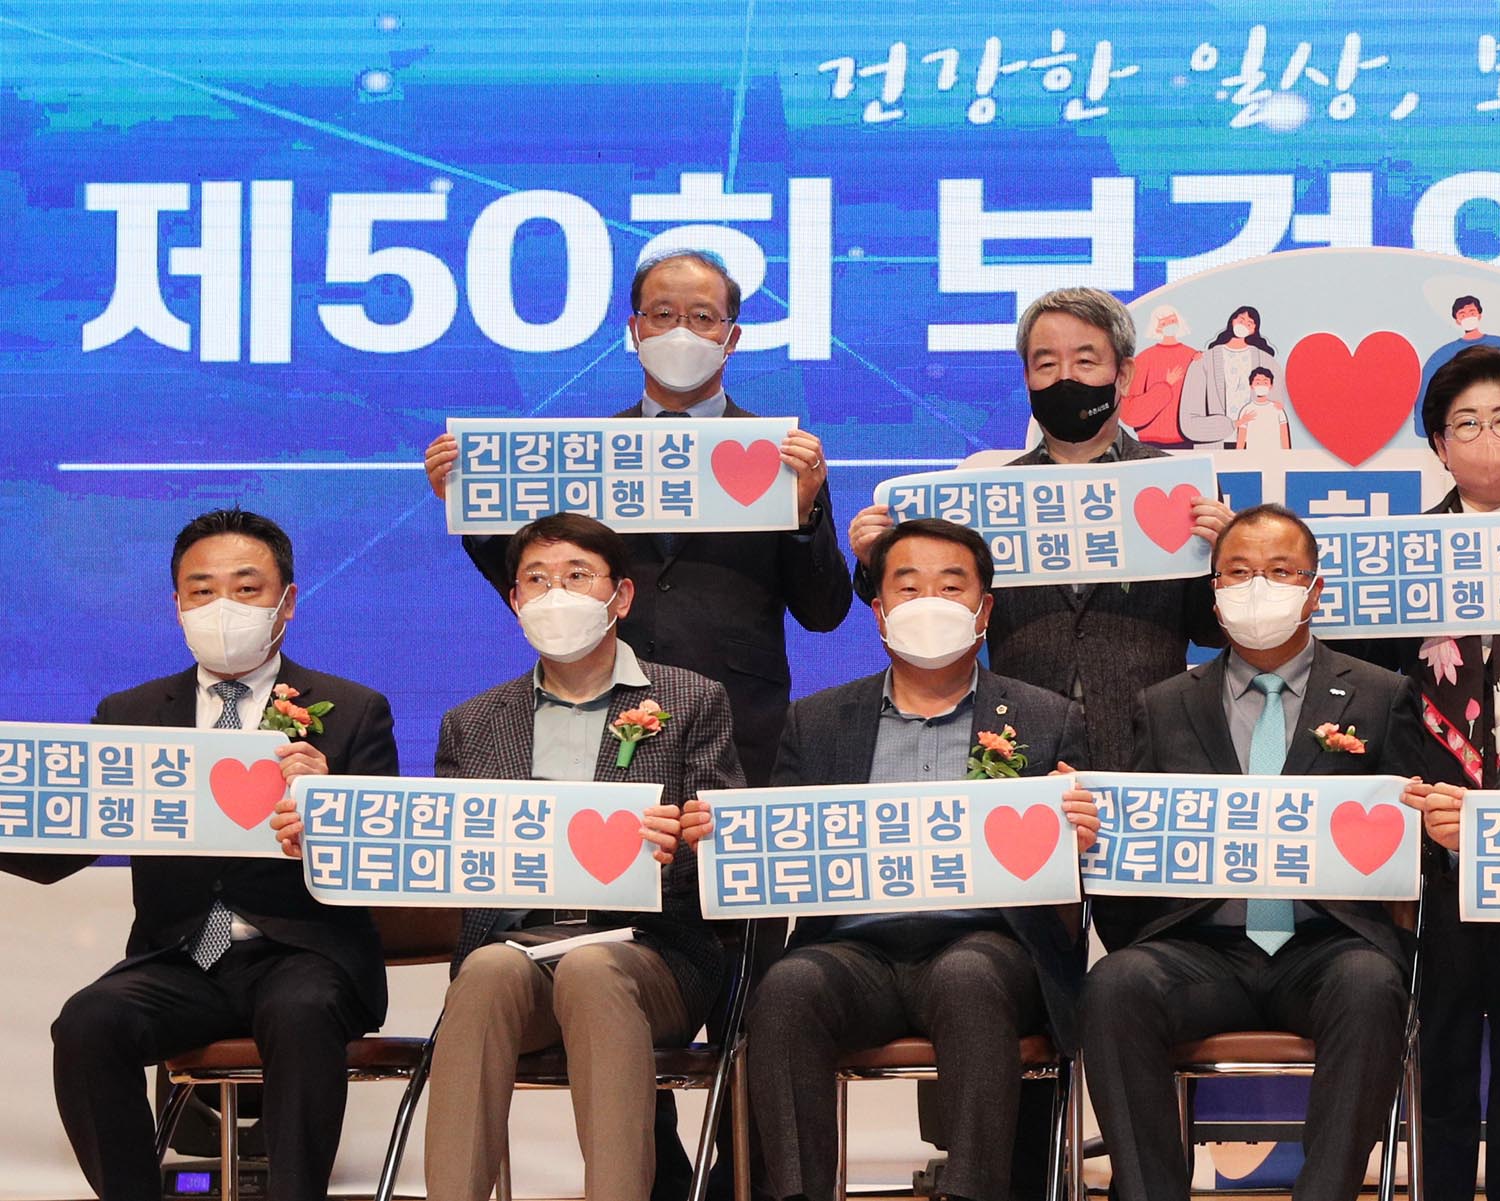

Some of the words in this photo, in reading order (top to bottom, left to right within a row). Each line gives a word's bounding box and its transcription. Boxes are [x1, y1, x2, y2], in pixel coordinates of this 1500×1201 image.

[819, 27, 1138, 125] 건강한
[1190, 25, 1420, 129] 일상,
[82, 172, 832, 364] 제50회
[467, 433, 599, 473] 건강한
[611, 434, 694, 470] 일상
[467, 481, 597, 519] 모두의
[612, 480, 693, 517] 행복
[893, 483, 1022, 525] 건강한
[1032, 482, 1116, 526] 일상
[1036, 531, 1119, 571] 행복
[1318, 533, 1439, 577] 건강한
[1312, 582, 1431, 623] 모두의
[0, 743, 85, 785] 강한
[98, 746, 190, 788] 일상
[0, 794, 81, 836] 두의
[99, 797, 189, 839] 행복
[311, 793, 450, 837] 건강한
[463, 797, 550, 841] 일상
[720, 804, 865, 851] 건강한
[875, 800, 965, 845] 일상
[1227, 792, 1313, 832] 일상
[311, 845, 445, 890] 모두의
[461, 849, 548, 894] 행복
[722, 858, 865, 903] 모두의
[878, 853, 967, 898] 행복
[1223, 841, 1310, 884] 행복
